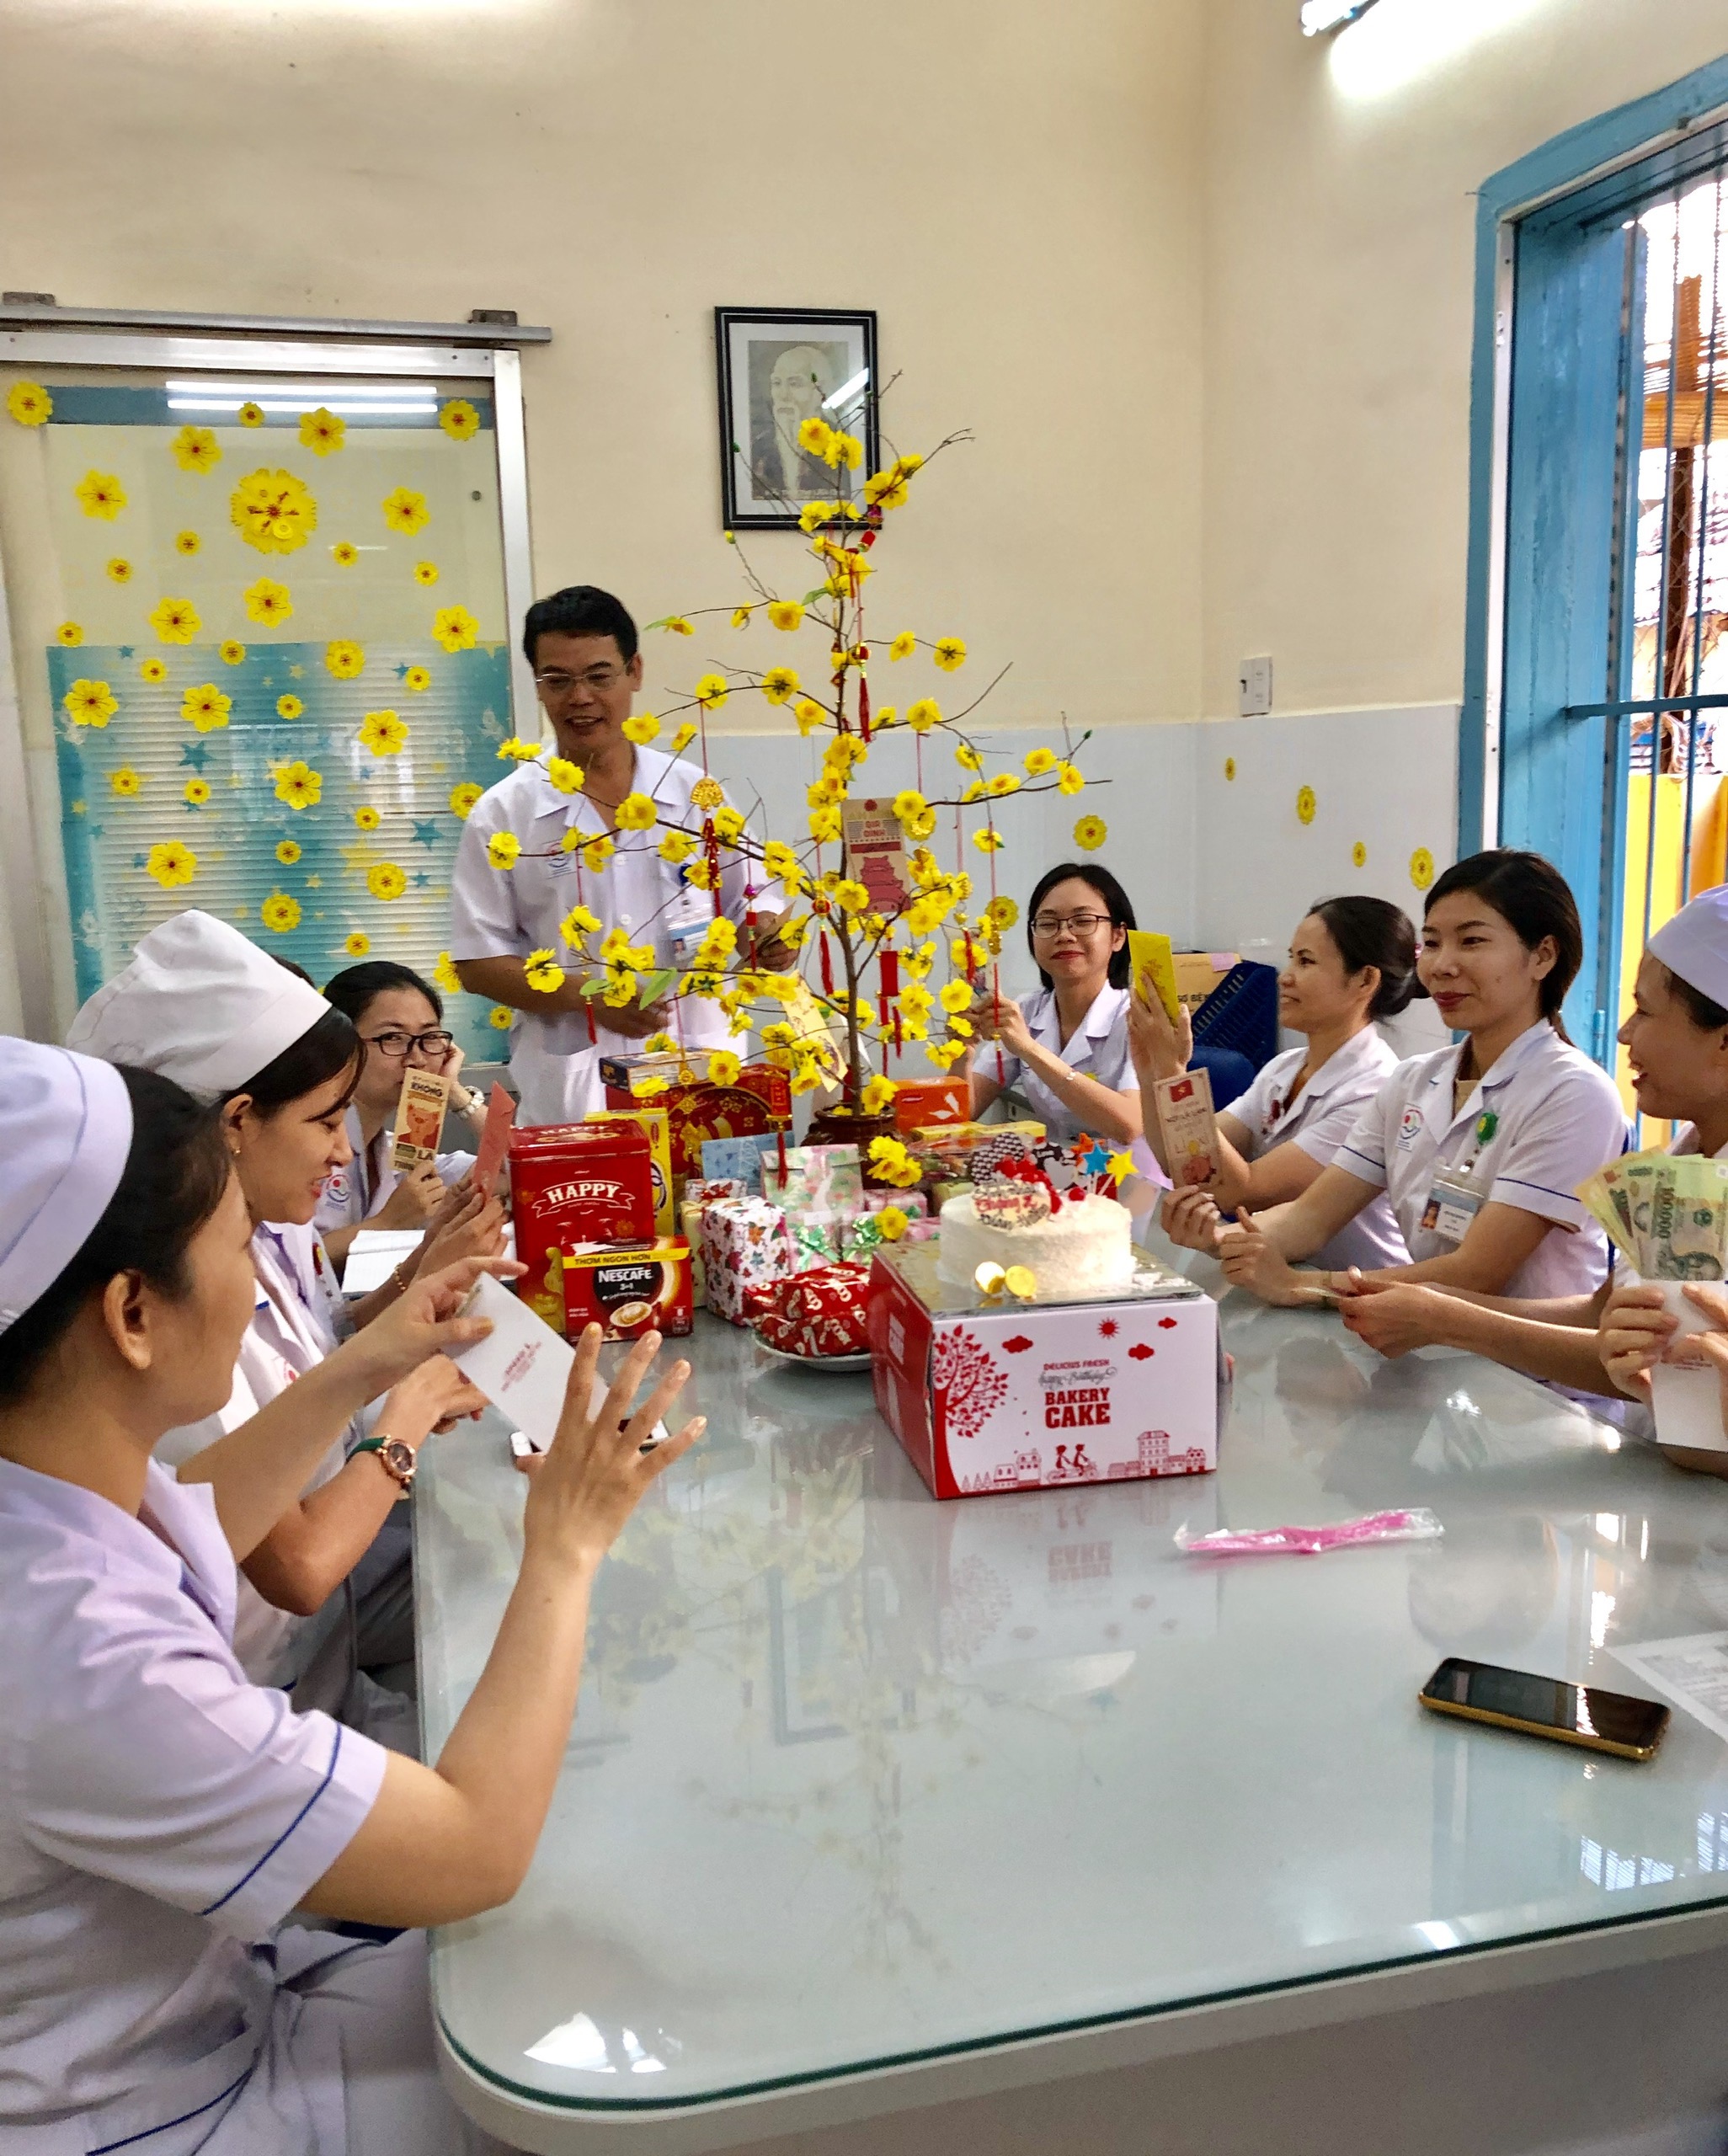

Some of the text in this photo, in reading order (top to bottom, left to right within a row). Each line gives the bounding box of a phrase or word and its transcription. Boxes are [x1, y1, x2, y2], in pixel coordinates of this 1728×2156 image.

[546, 1182, 621, 1203] HAPPY
[603, 1255, 629, 1263] NGON
[1082, 1358, 1110, 1367] FRESH
[1045, 1387, 1110, 1406] BAKERY
[1045, 1403, 1111, 1428] CAKE
